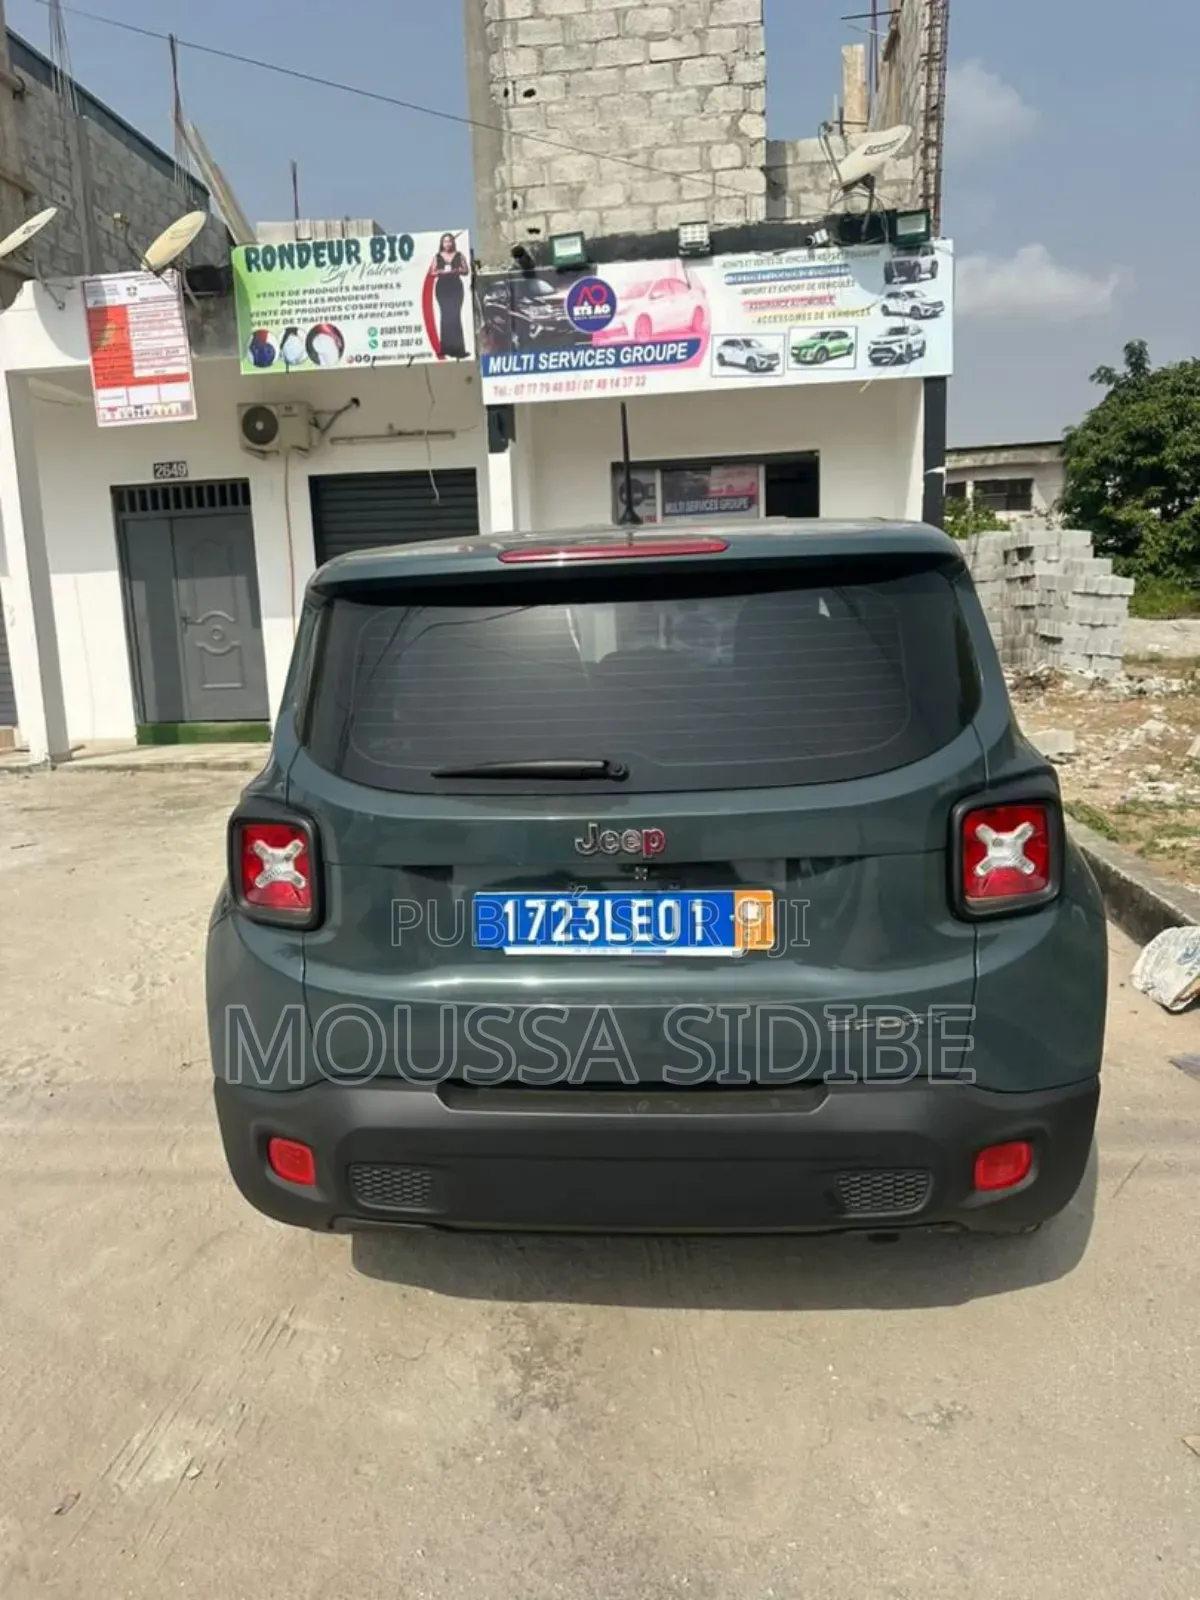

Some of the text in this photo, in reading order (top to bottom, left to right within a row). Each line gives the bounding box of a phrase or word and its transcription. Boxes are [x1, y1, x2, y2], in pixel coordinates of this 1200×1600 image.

[244, 234, 415, 273] RONDEUR BIO
[256, 291, 285, 299] VENTE
[302, 286, 350, 295] PRODUITS
[352, 282, 402, 292] NATURELS
[280, 298, 306, 306] POUR
[326, 293, 381, 303] RONDEURS
[250, 308, 279, 317] VENTE
[280, 306, 293, 316] DE
[295, 303, 343, 314] PRODUITS
[250, 309, 410, 327] VENTE DE TRAITEMENT AFRICAINS
[489, 342, 688, 374] MULTI SERVICES GROUPE
[574, 822, 666, 858] Jeep
[503, 899, 703, 943] 1723LE01
